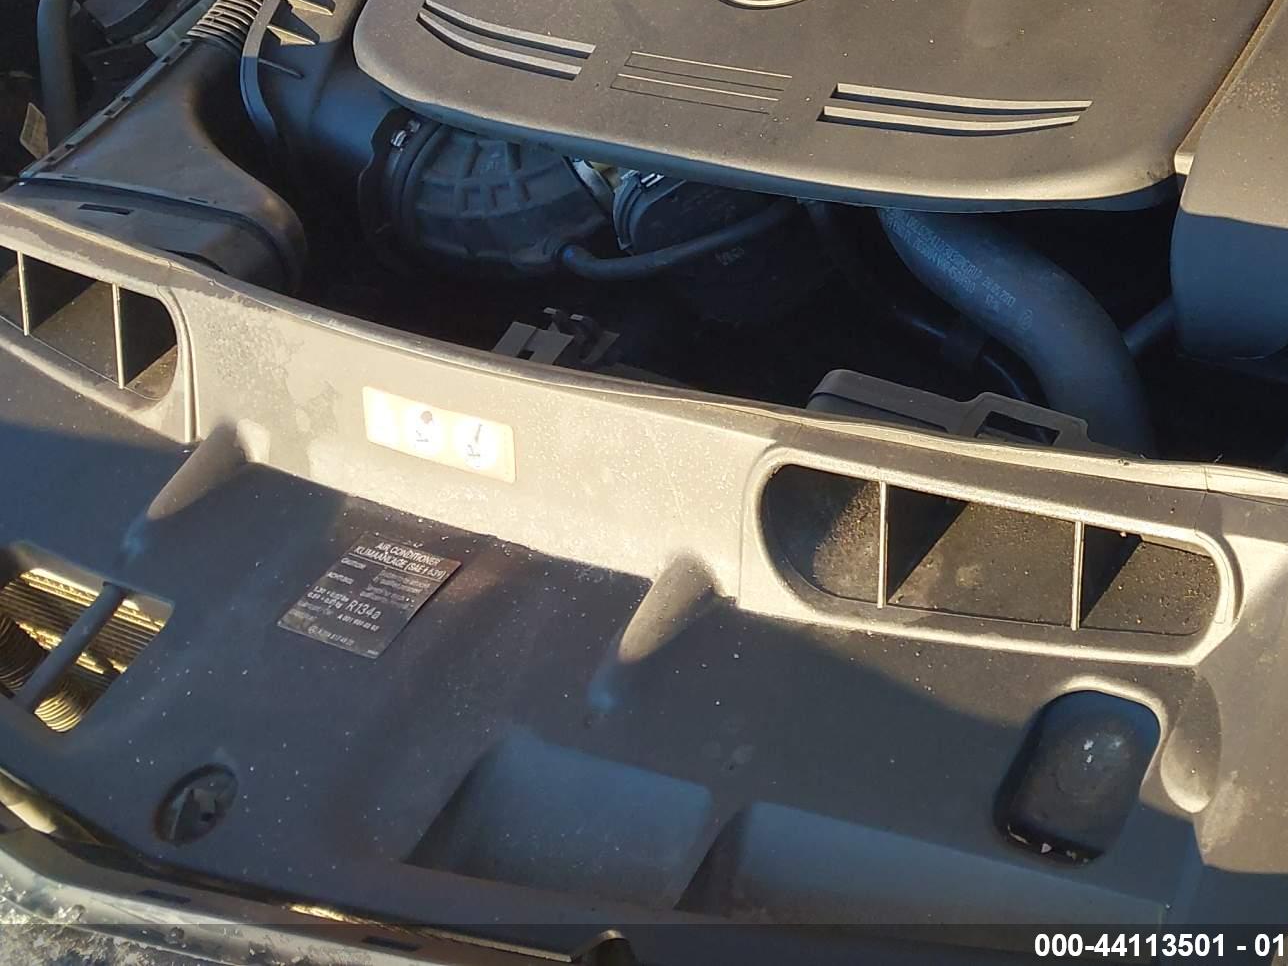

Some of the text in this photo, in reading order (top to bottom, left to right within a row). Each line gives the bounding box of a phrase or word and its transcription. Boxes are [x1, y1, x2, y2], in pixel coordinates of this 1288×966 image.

[353, 545, 407, 568] KLIMAANLAGE
[374, 541, 441, 566] AIR CONDITIONER
[345, 600, 382, 620] R134a
